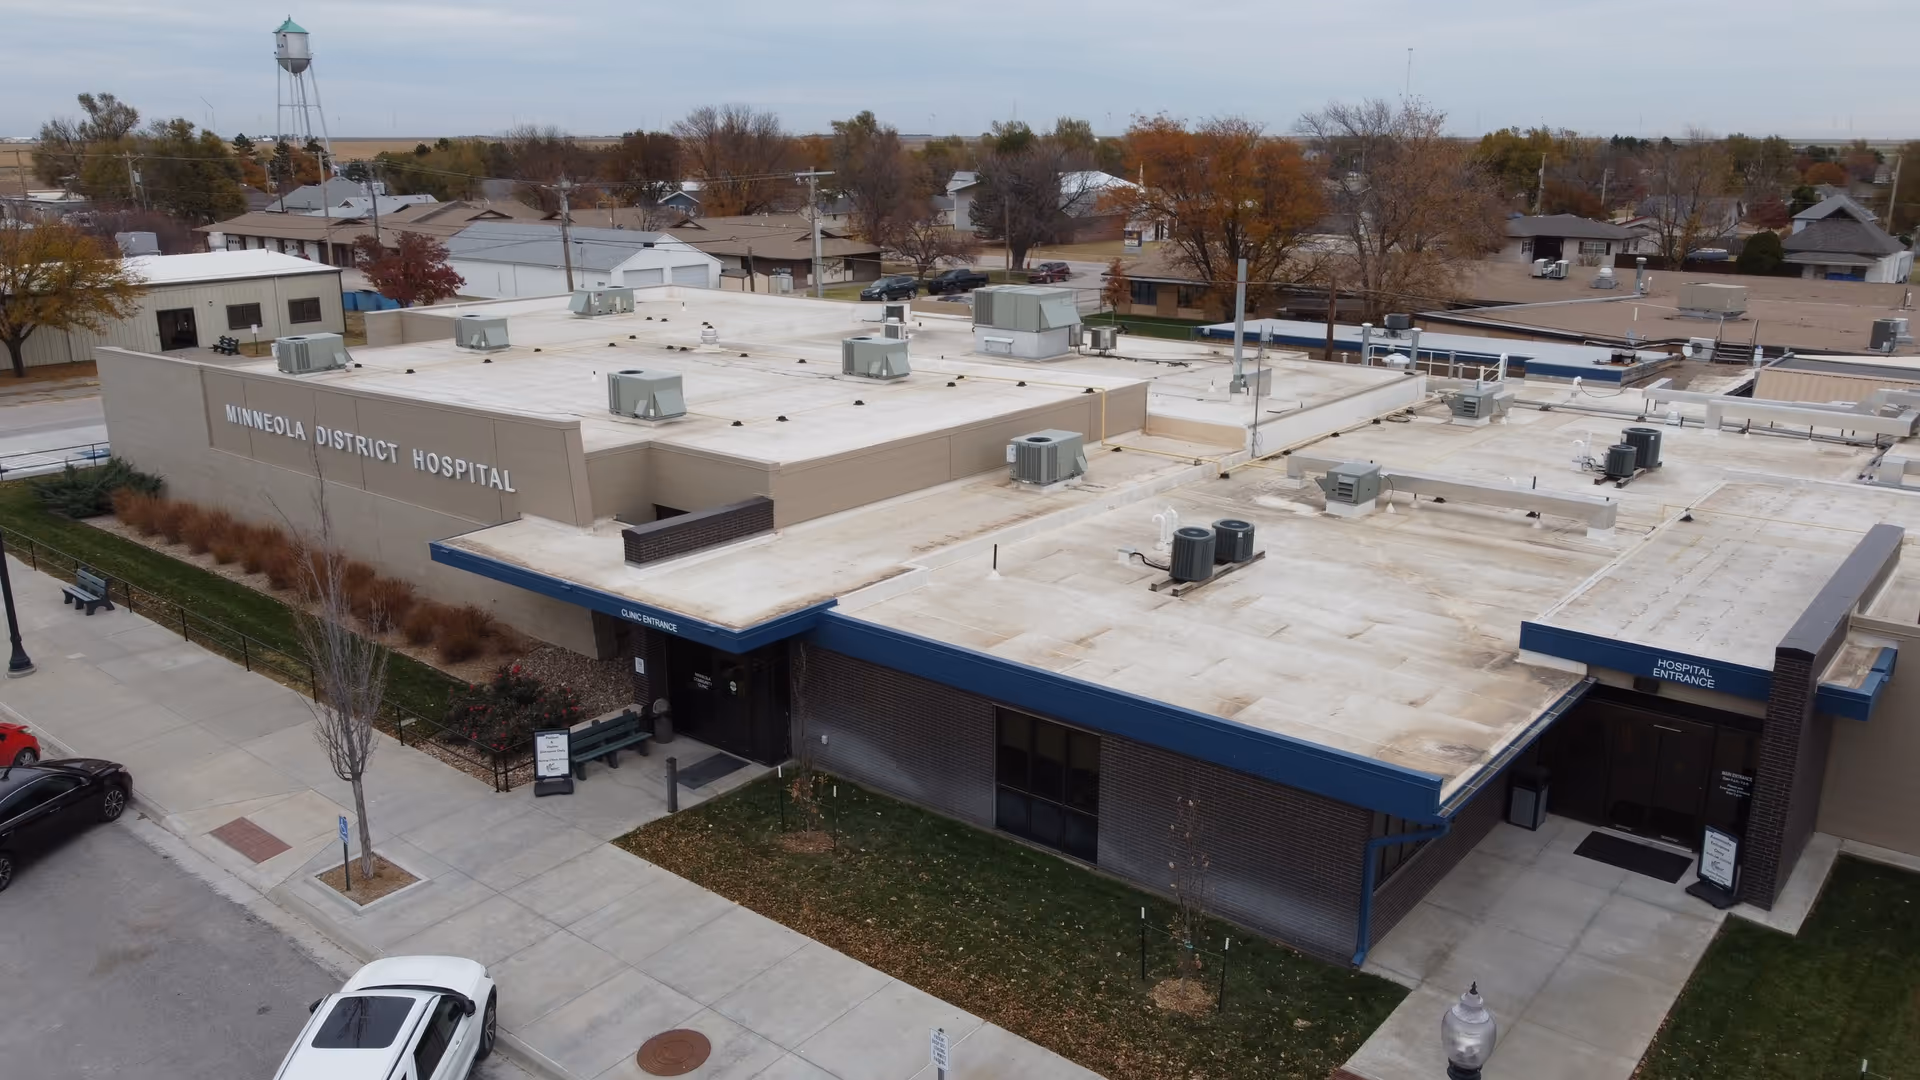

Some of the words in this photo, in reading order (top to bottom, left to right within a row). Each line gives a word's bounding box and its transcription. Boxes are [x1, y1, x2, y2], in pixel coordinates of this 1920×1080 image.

[225, 404, 306, 441] MINNEOLA
[315, 425, 398, 463] DISTRICT
[412, 448, 516, 493] HOSPITAL
[621, 608, 642, 622] CLINIC
[642, 614, 678, 633] ENTRANCE
[1652, 667, 1716, 689] ENTRANCE
[1657, 658, 1713, 678] HOSPITAL
